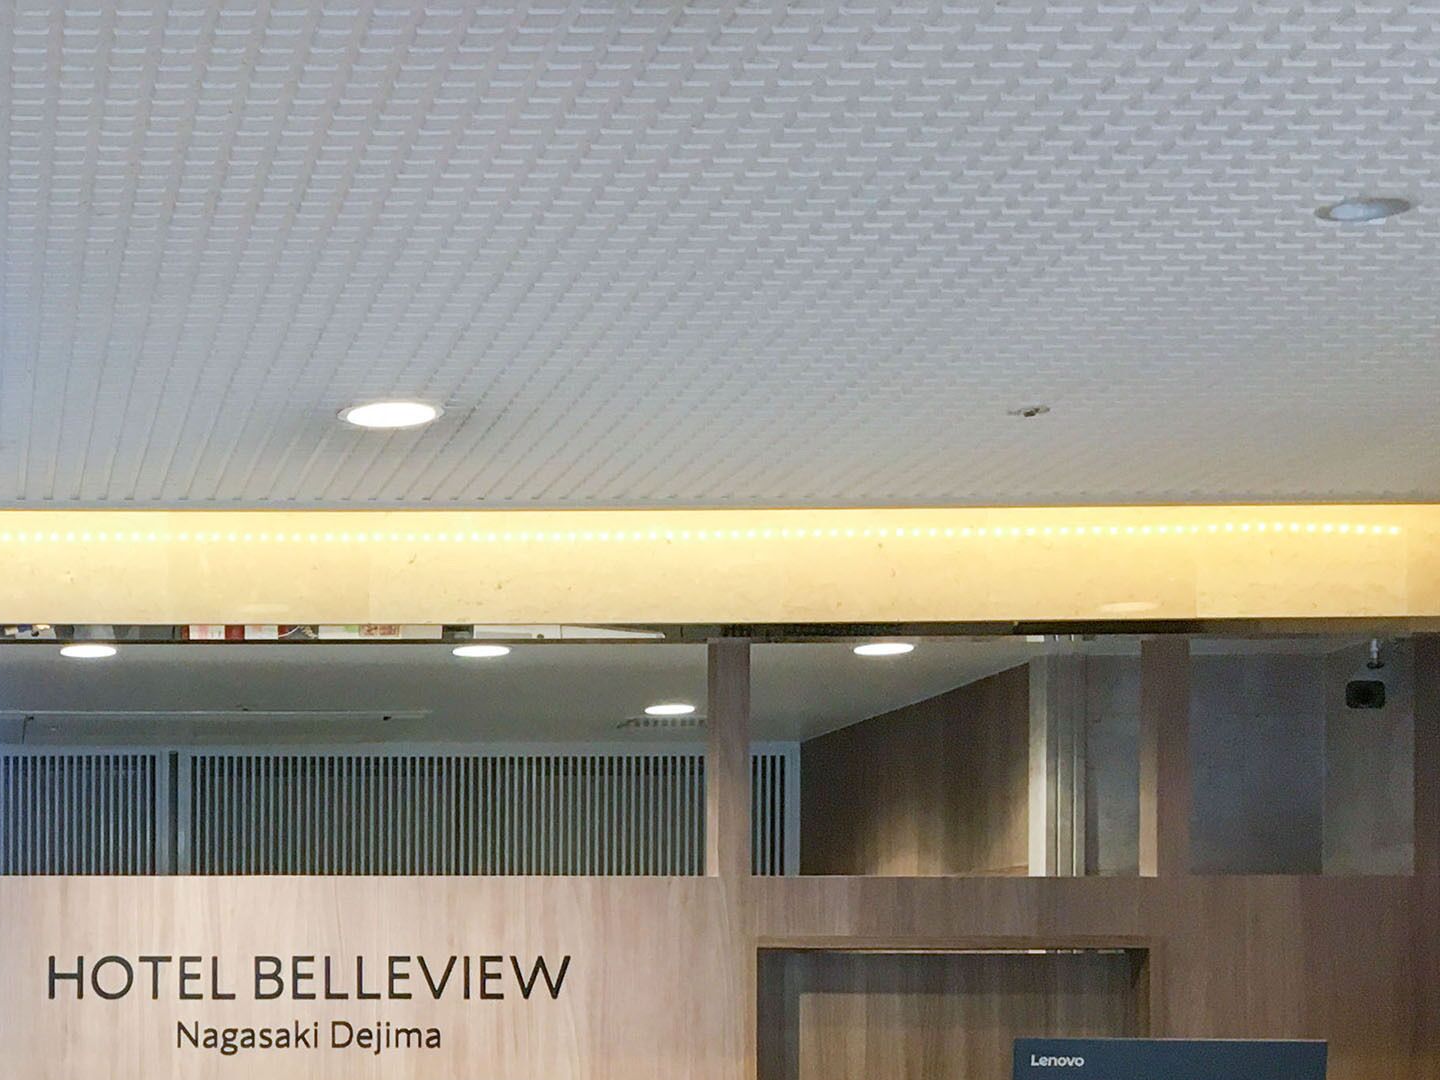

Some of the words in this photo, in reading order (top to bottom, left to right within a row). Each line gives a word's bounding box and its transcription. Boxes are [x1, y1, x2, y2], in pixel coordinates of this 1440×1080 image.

[48, 955, 236, 1000] HOTEL
[254, 955, 571, 1000] BELLEVIEW
[177, 1020, 319, 1056] Nagasaki
[331, 1021, 441, 1056] Dejima
[1030, 1054, 1085, 1067] Lenovo
